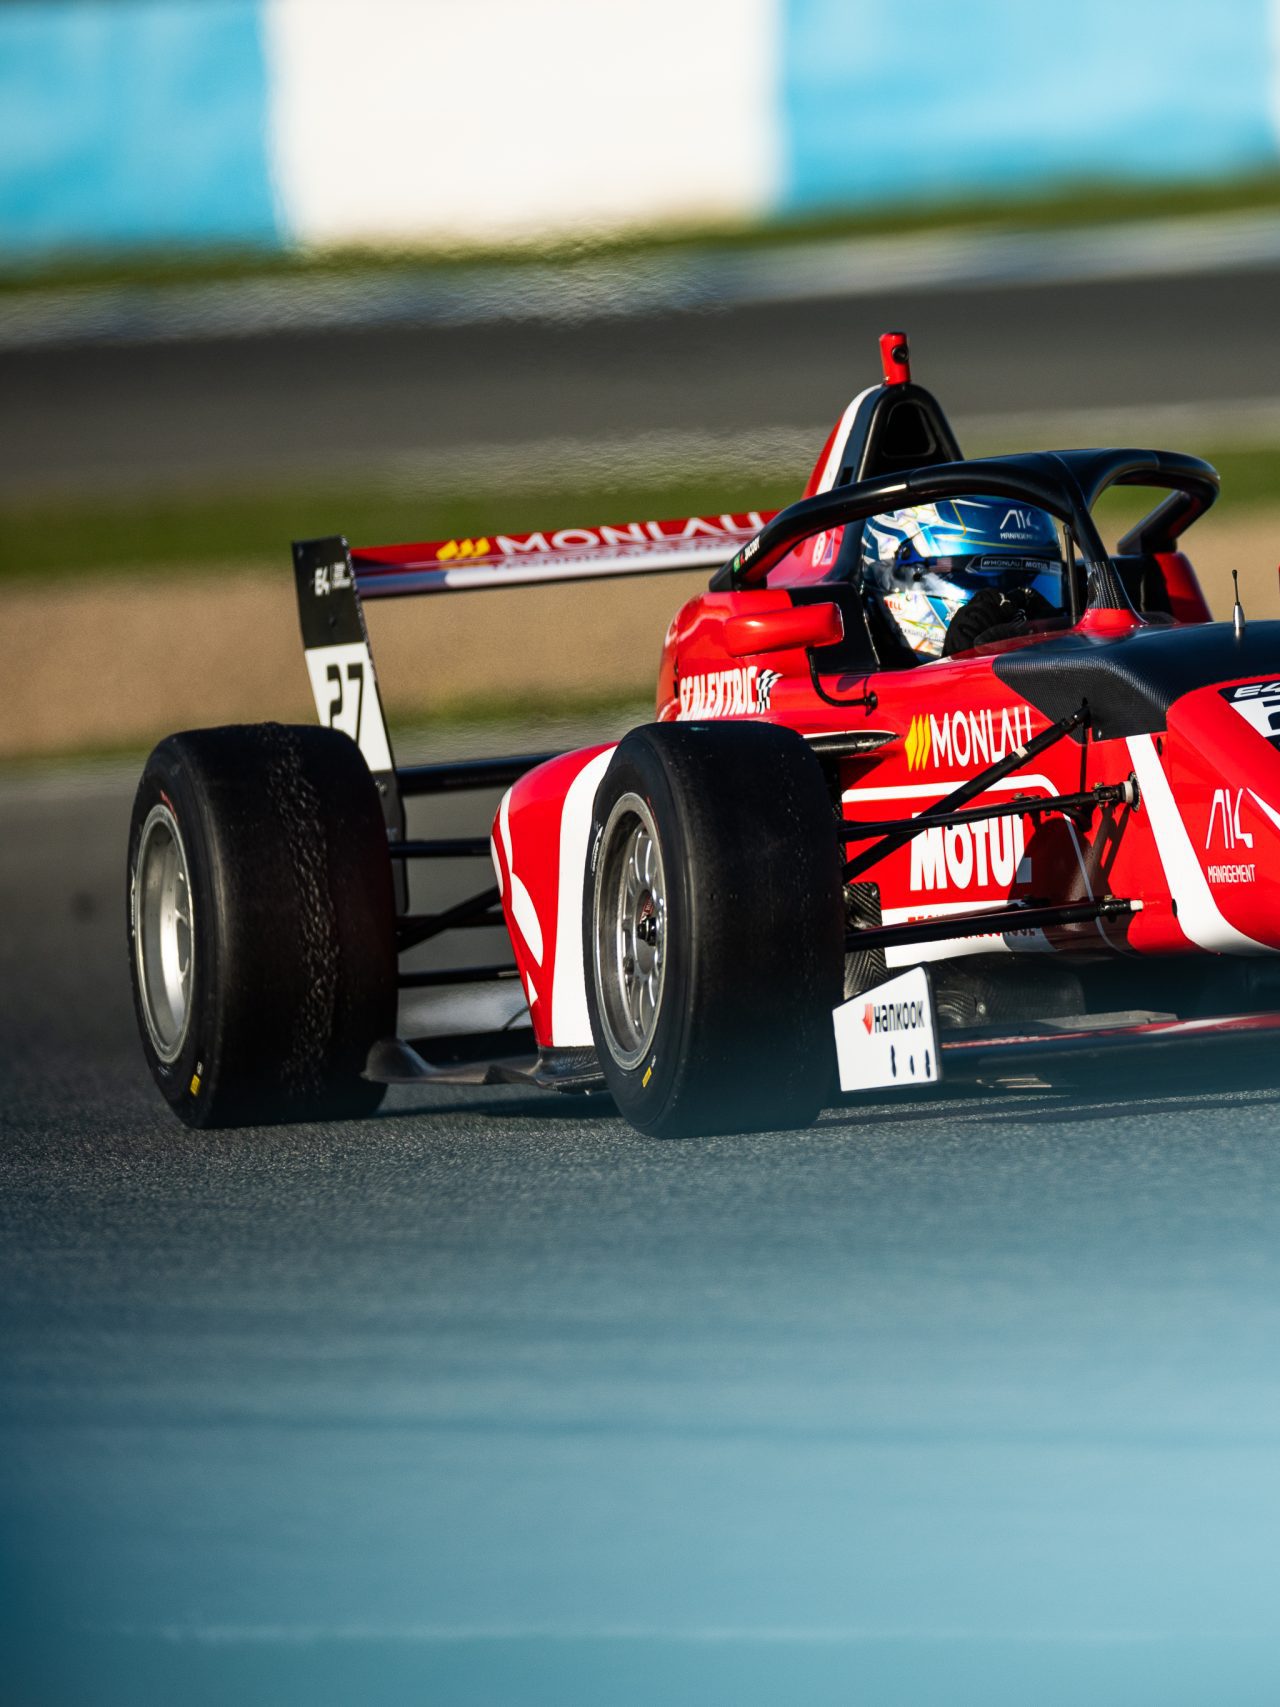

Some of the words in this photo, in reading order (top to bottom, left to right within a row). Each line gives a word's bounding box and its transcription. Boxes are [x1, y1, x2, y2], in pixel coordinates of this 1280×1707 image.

[496, 512, 766, 555] MONLAU
[327, 663, 364, 742] 27
[676, 665, 758, 721] SCALEXTRIC
[929, 705, 1033, 769] MONLAU
[909, 812, 1033, 892] MOTUL
[1207, 864, 1256, 884] MANAGEMENT
